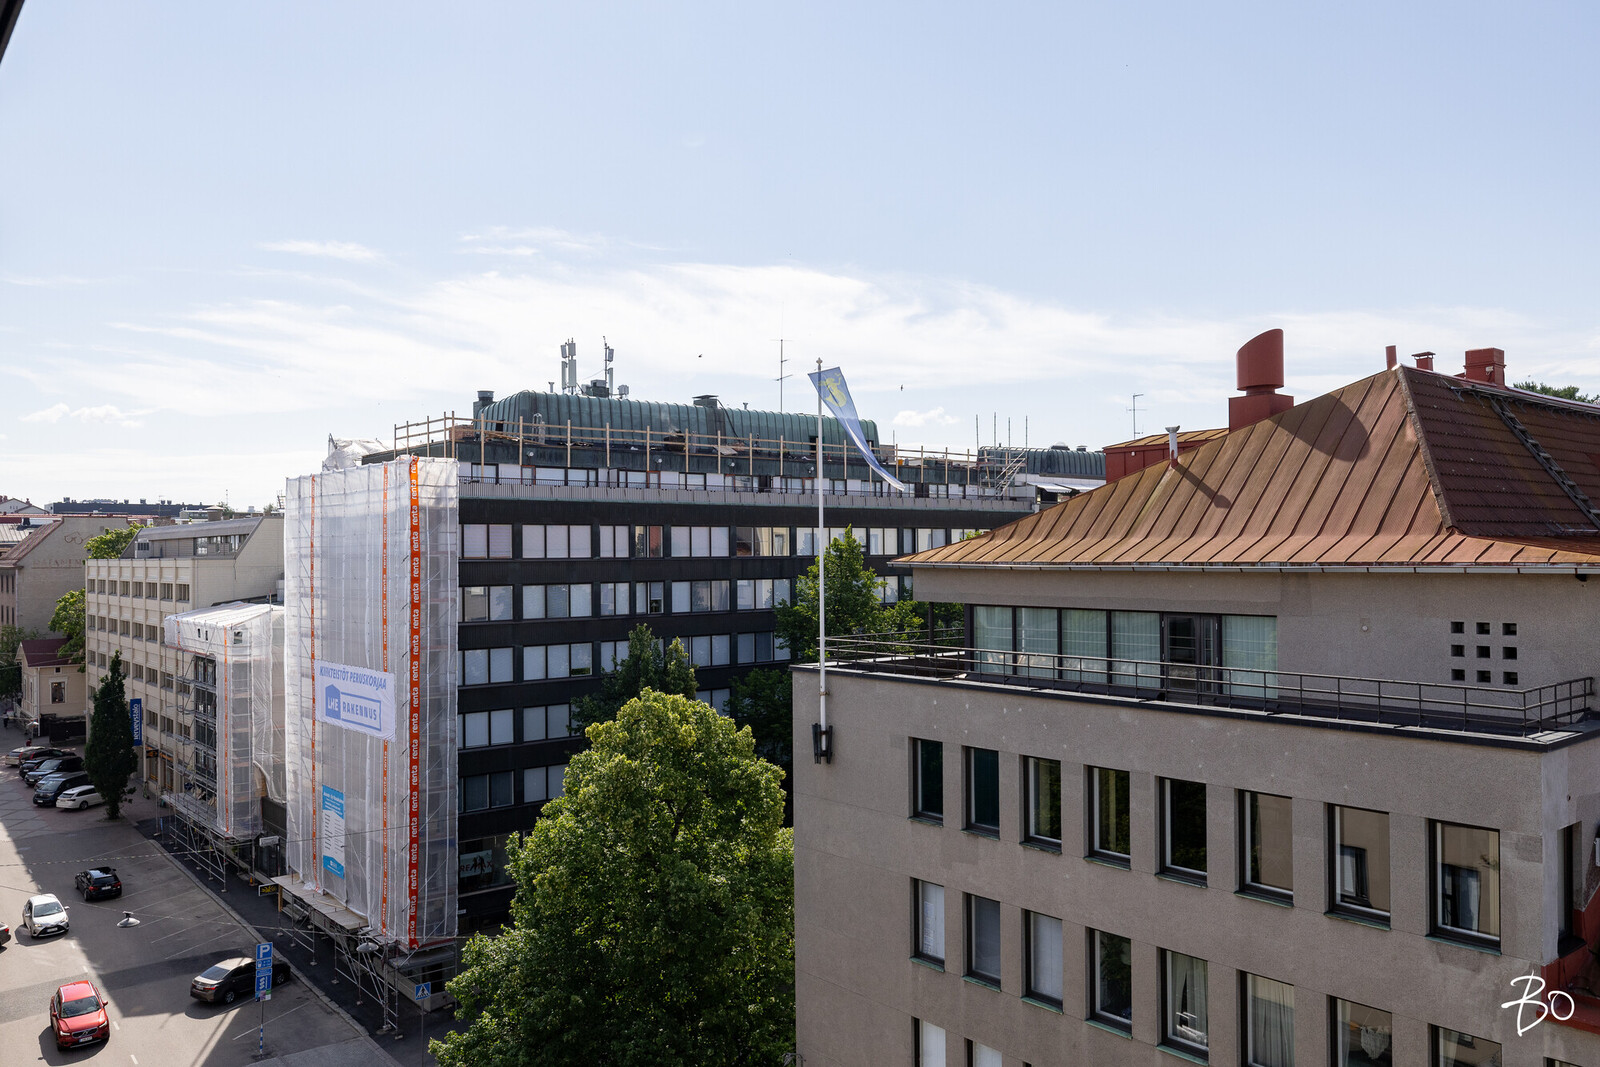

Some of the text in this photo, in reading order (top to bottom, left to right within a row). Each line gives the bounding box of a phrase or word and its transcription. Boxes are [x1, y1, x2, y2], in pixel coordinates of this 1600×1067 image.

[350, 671, 387, 691] PERUSKORJAA
[342, 701, 377, 720] RAKENNUS
[260, 944, 270, 959] P
